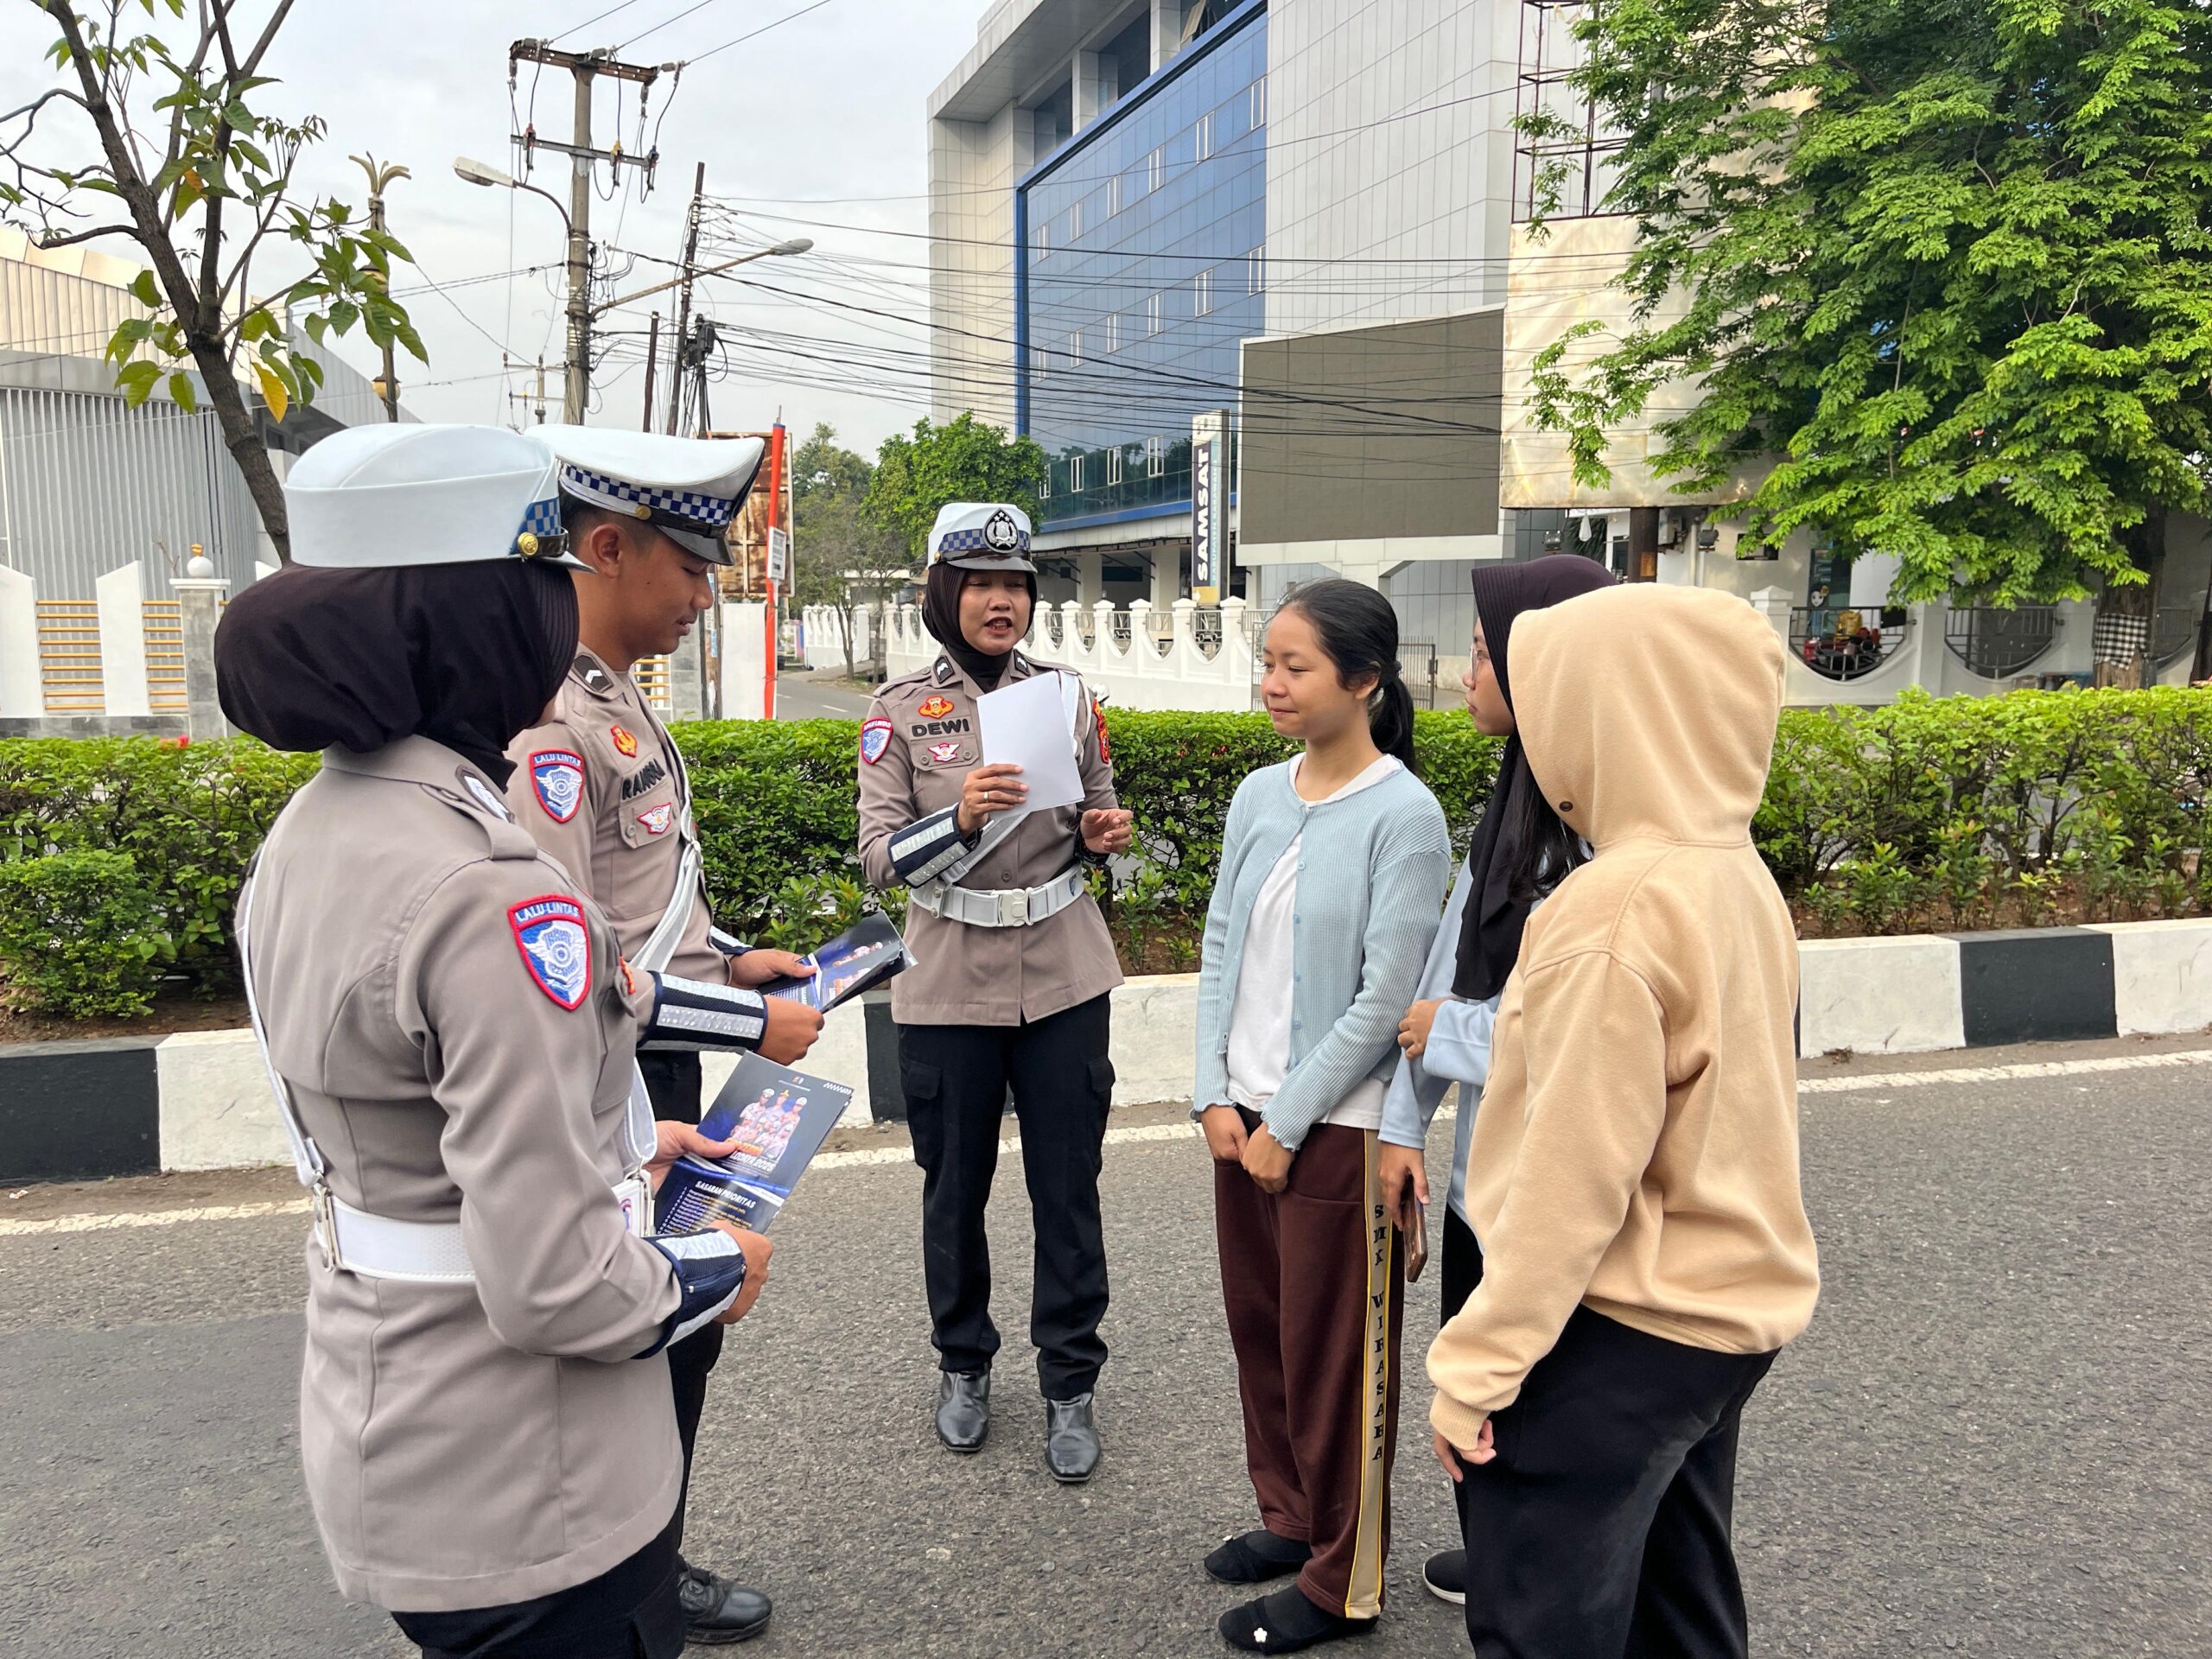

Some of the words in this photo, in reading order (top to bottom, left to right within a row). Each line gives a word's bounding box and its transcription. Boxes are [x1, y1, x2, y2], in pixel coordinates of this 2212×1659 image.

[1198, 448, 1209, 582] SAMSAT
[912, 718, 969, 737] DEWI
[534, 754, 556, 764] LALU
[556, 753, 581, 766] LINTAS
[515, 903, 546, 922] LALU
[546, 901, 580, 917] LINTAS
[695, 1180, 724, 1196] SASARAN
[721, 1188, 757, 1209] PRIORITAS
[1373, 1204, 1387, 1267] SMK
